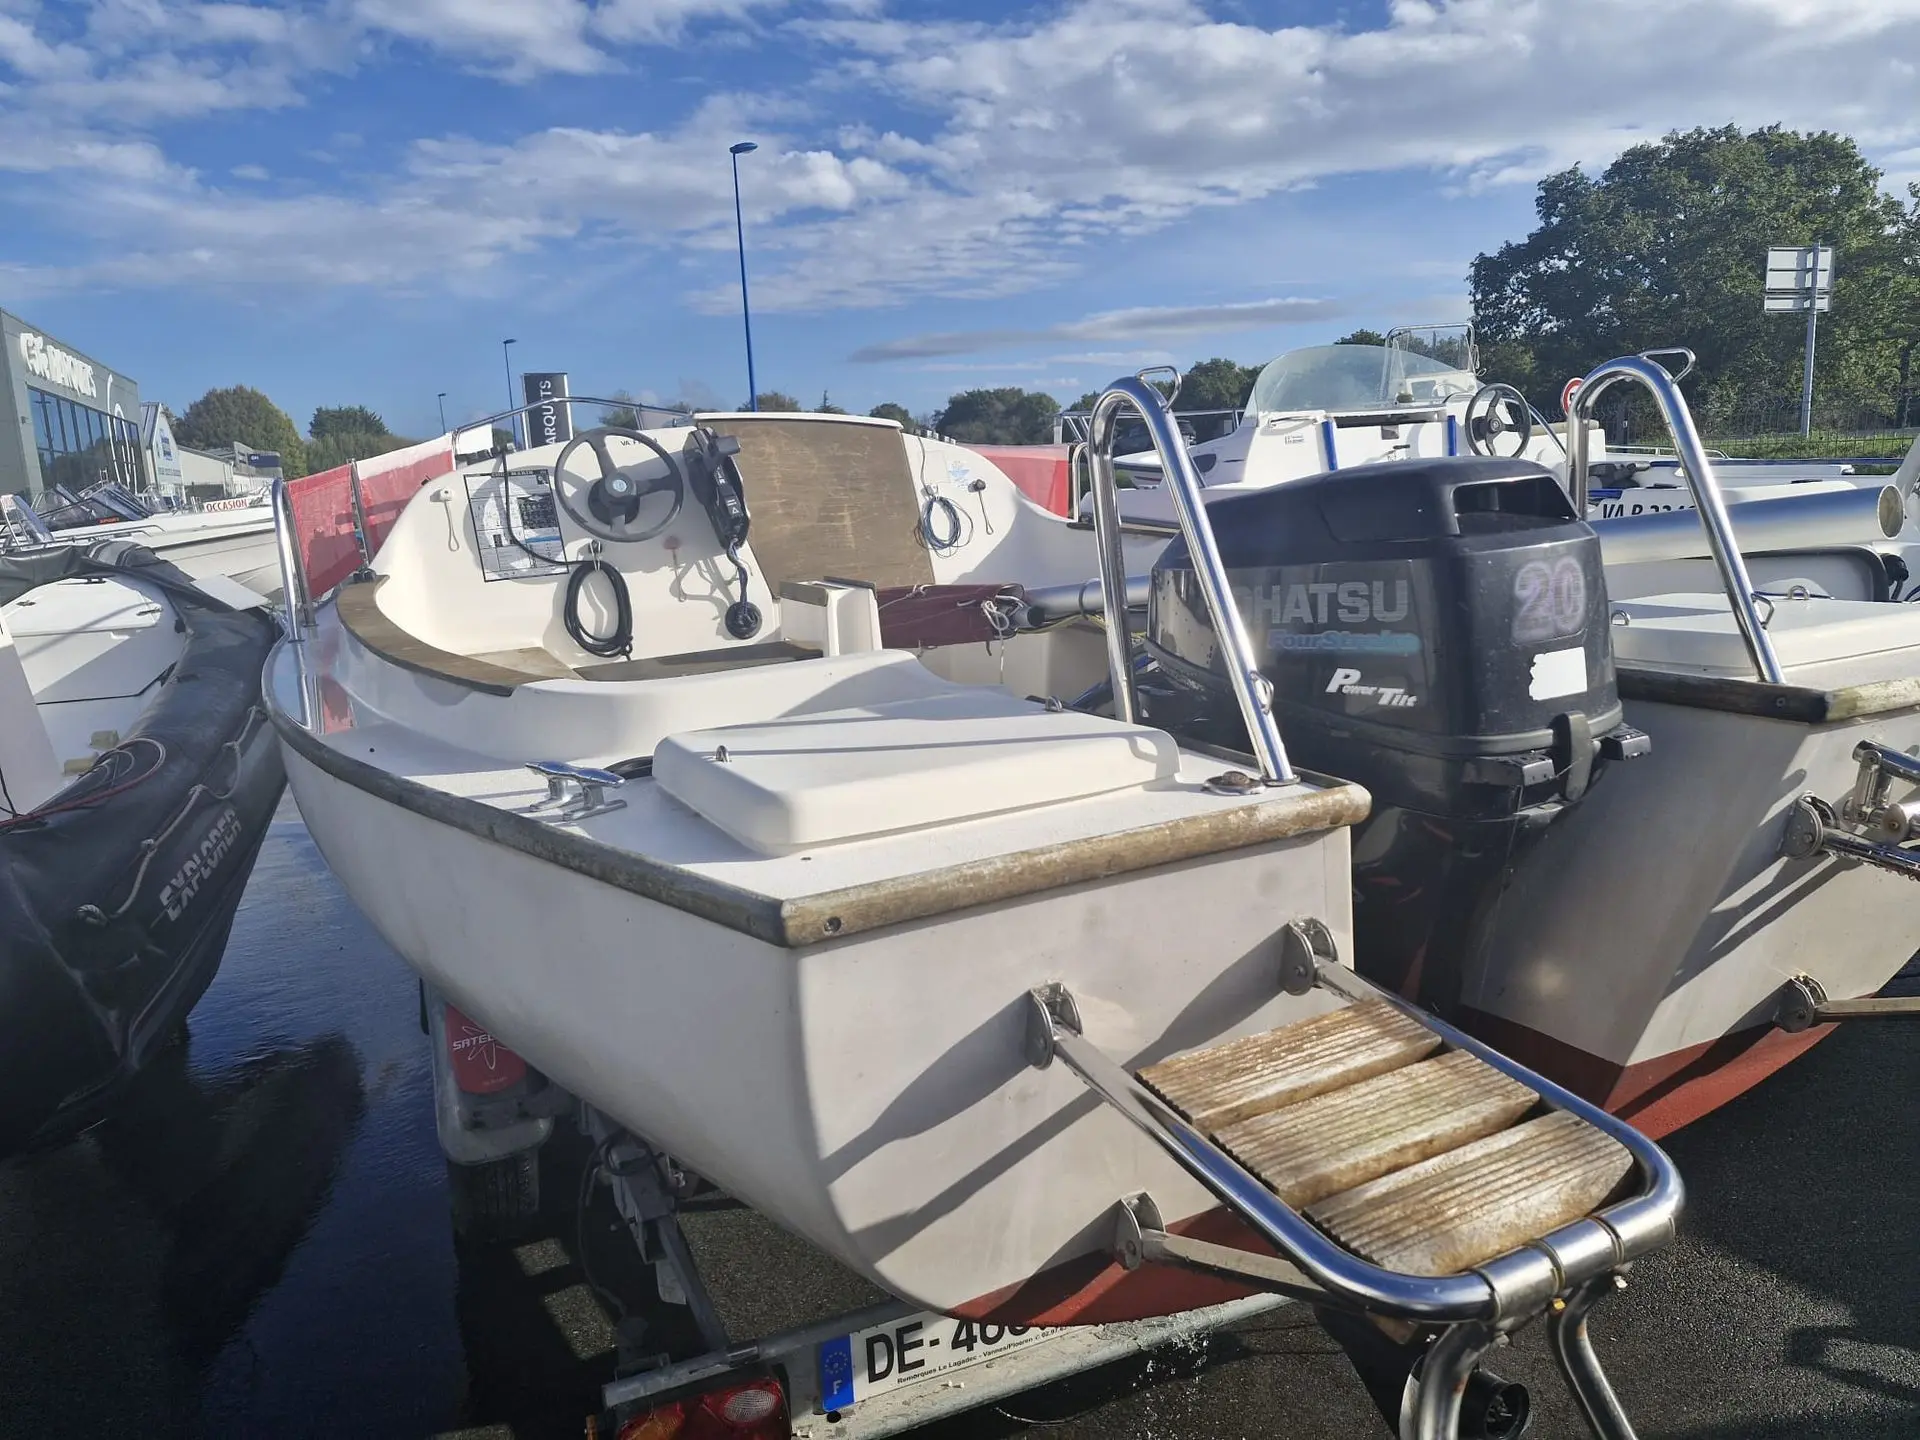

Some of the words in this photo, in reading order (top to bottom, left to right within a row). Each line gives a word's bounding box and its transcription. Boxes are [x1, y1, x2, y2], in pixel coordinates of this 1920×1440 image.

[540, 380, 557, 444] ARQUTS
[206, 499, 248, 512] OCCASION
[1512, 556, 1586, 640] 20
[160, 809, 241, 921] EXPLORER
[832, 1380, 842, 1395] F
[897, 1367, 937, 1385] Remorques
[948, 1354, 977, 1368] Lagadec
